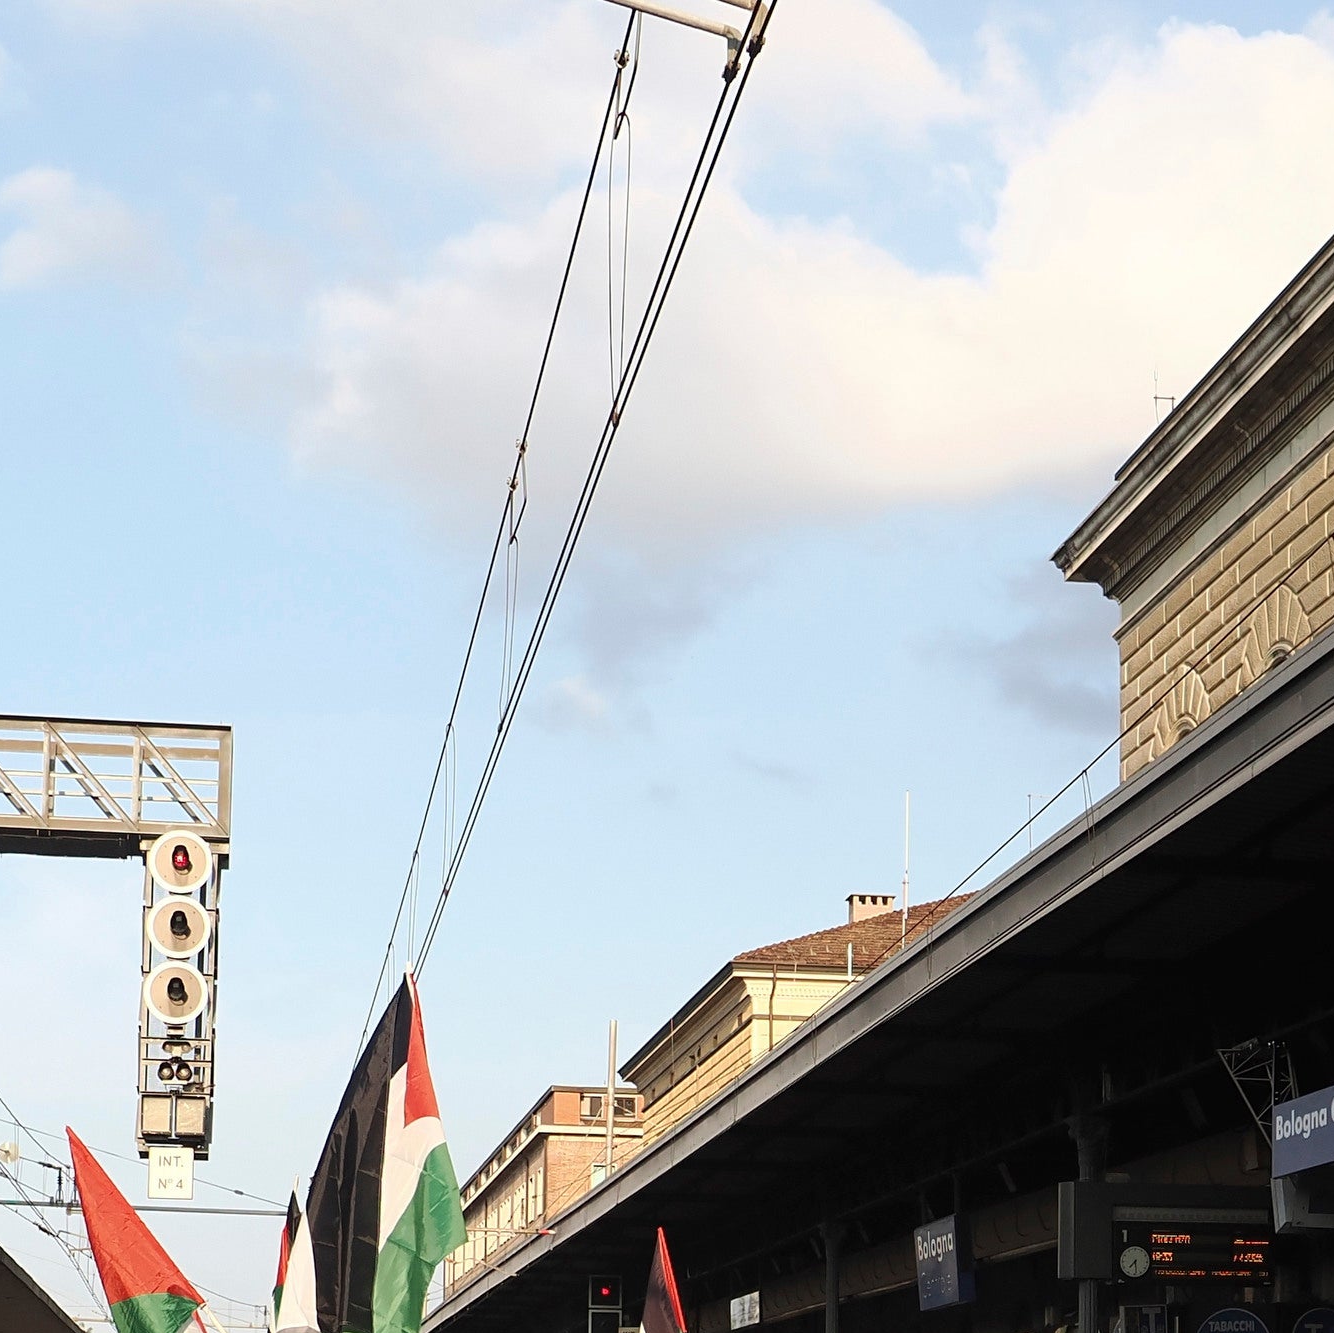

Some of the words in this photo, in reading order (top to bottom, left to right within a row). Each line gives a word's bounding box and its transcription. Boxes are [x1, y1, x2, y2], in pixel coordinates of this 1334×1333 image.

[1275, 1109, 1328, 1141] Bologna
[158, 1155, 184, 1168] INT.
[917, 1231, 954, 1262] Bologna
[1208, 1320, 1255, 1333] TABACCHI
